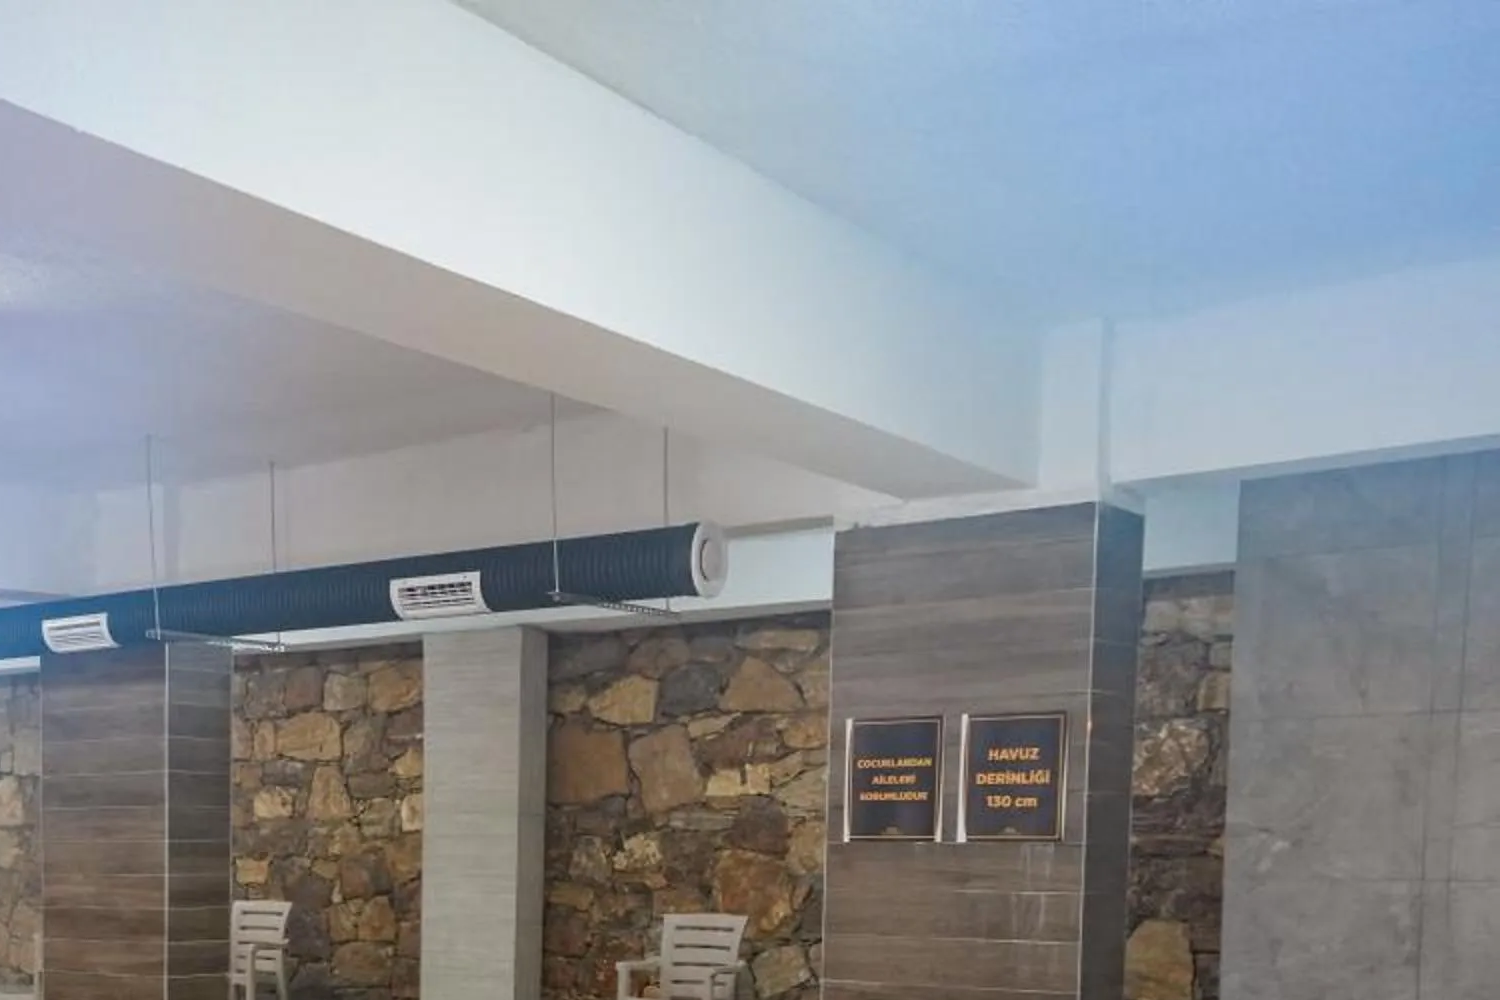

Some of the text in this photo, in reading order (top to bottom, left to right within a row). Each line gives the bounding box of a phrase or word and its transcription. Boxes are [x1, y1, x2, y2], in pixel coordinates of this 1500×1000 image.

[988, 747, 1040, 761] HAVUZ
[976, 769, 1051, 785] DERİNLİĞİ
[987, 795, 1038, 808] 130 cm
